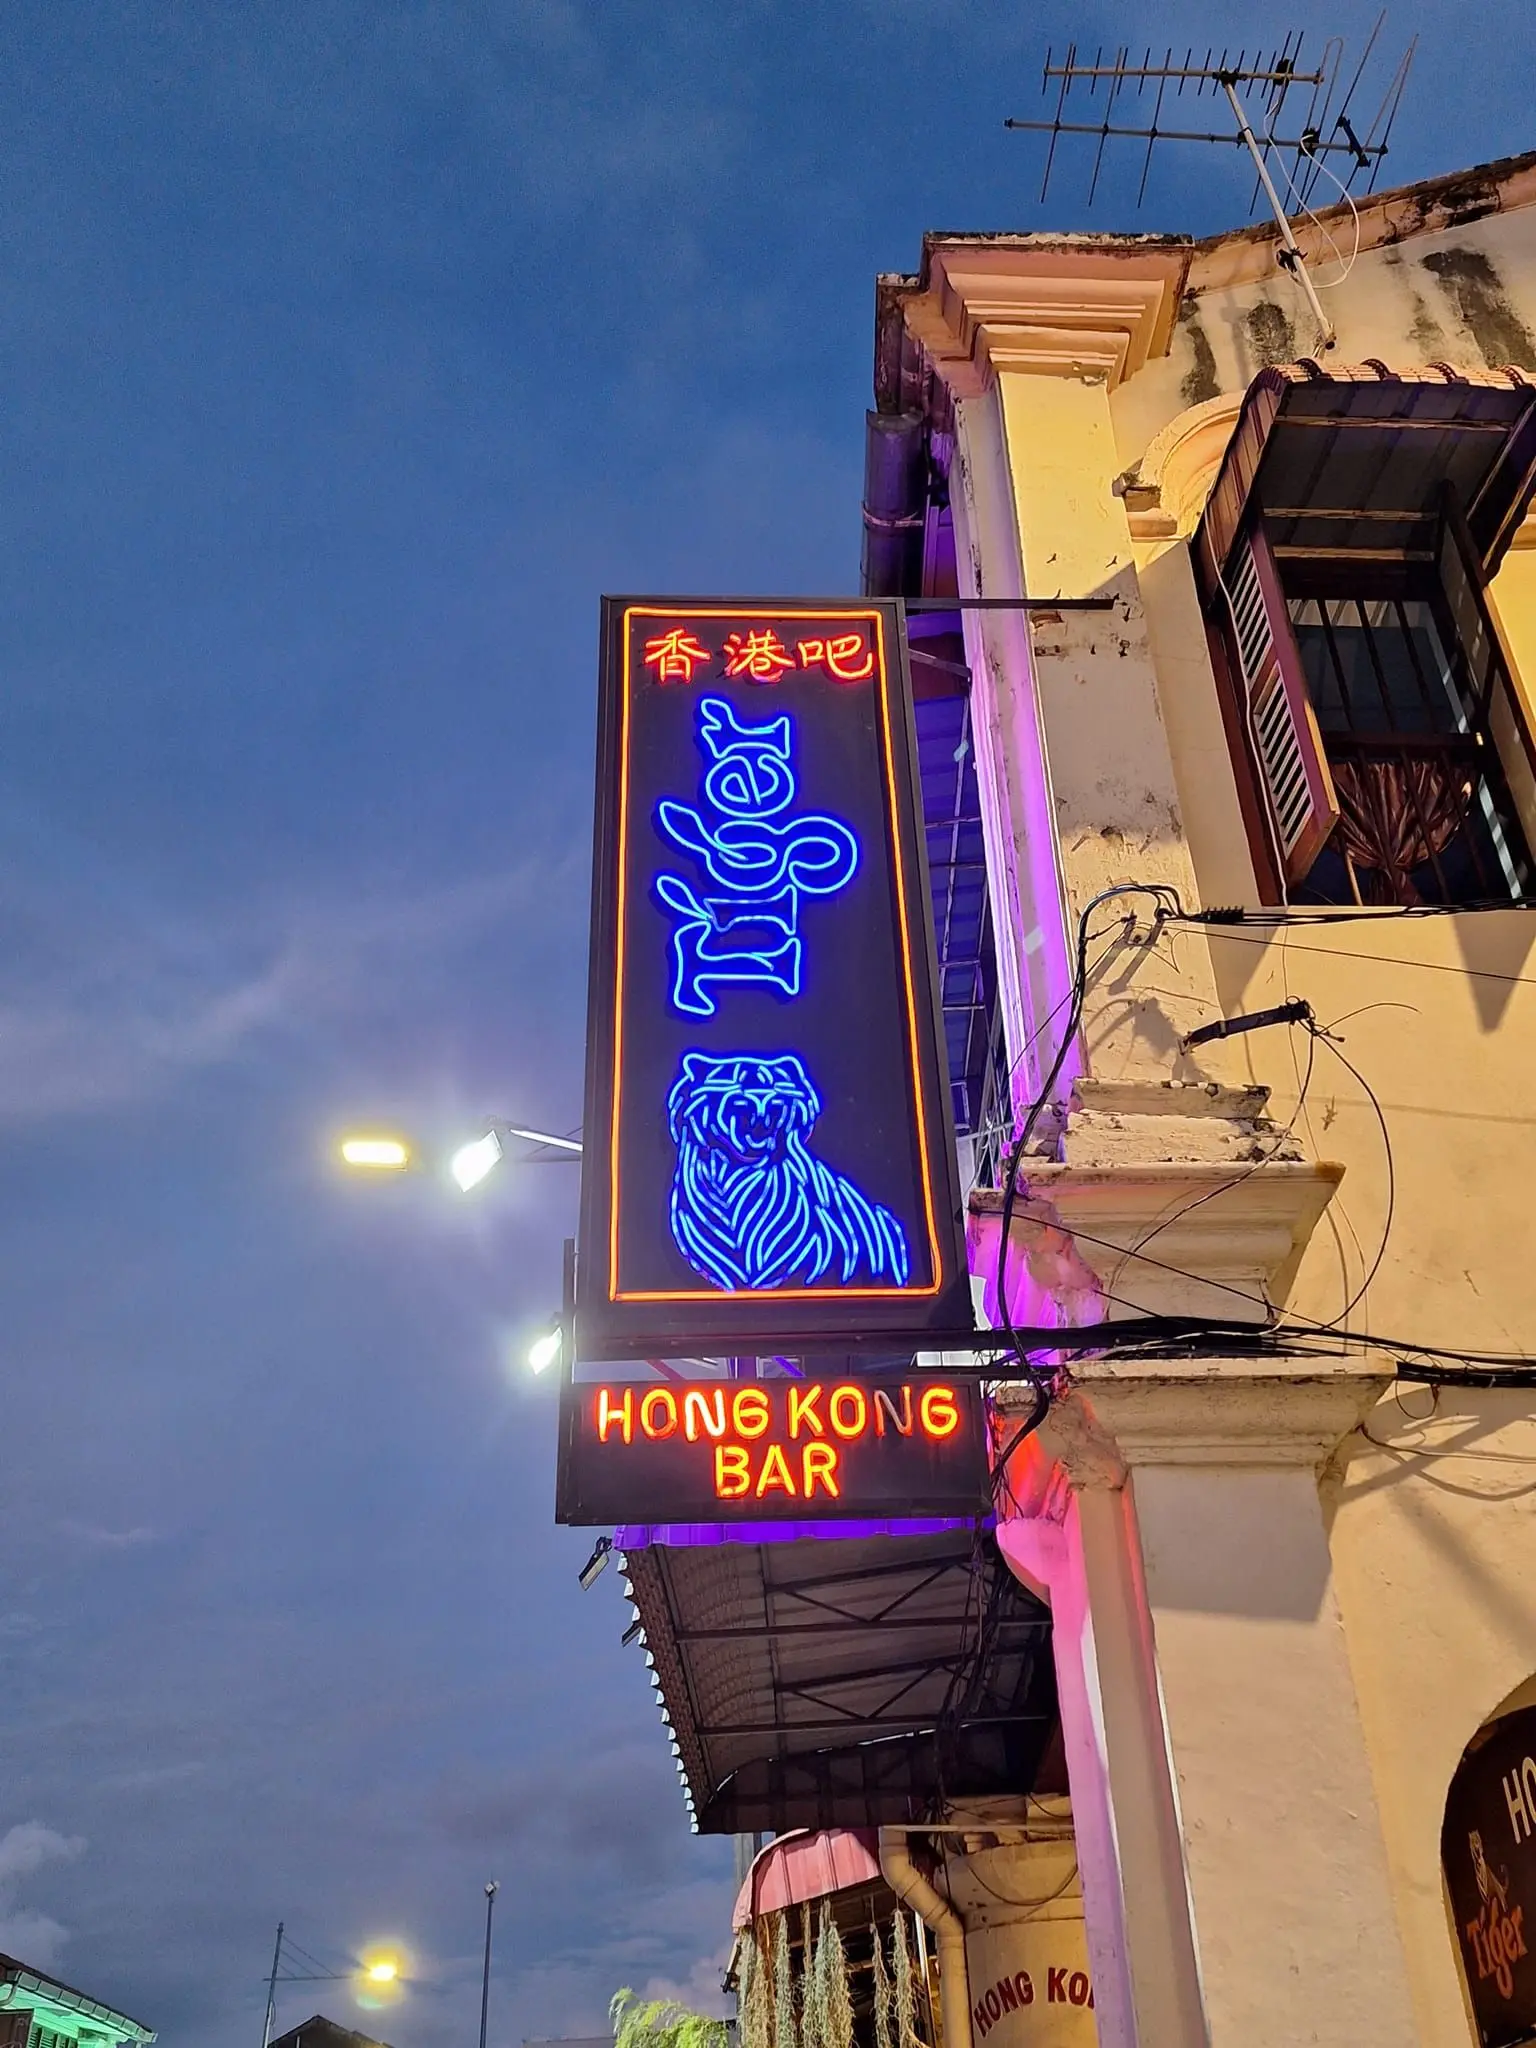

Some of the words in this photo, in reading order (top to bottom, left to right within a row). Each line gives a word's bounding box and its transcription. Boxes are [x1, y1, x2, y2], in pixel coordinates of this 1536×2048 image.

[645, 628, 874, 683] 香港吧
[656, 698, 858, 1016] Tiger
[597, 1386, 769, 1444] HONG
[788, 1384, 959, 1440] KONG
[714, 1441, 841, 1498] BAR
[1466, 1897, 1529, 2000] Tiger
[973, 1970, 1034, 2038] HONG
